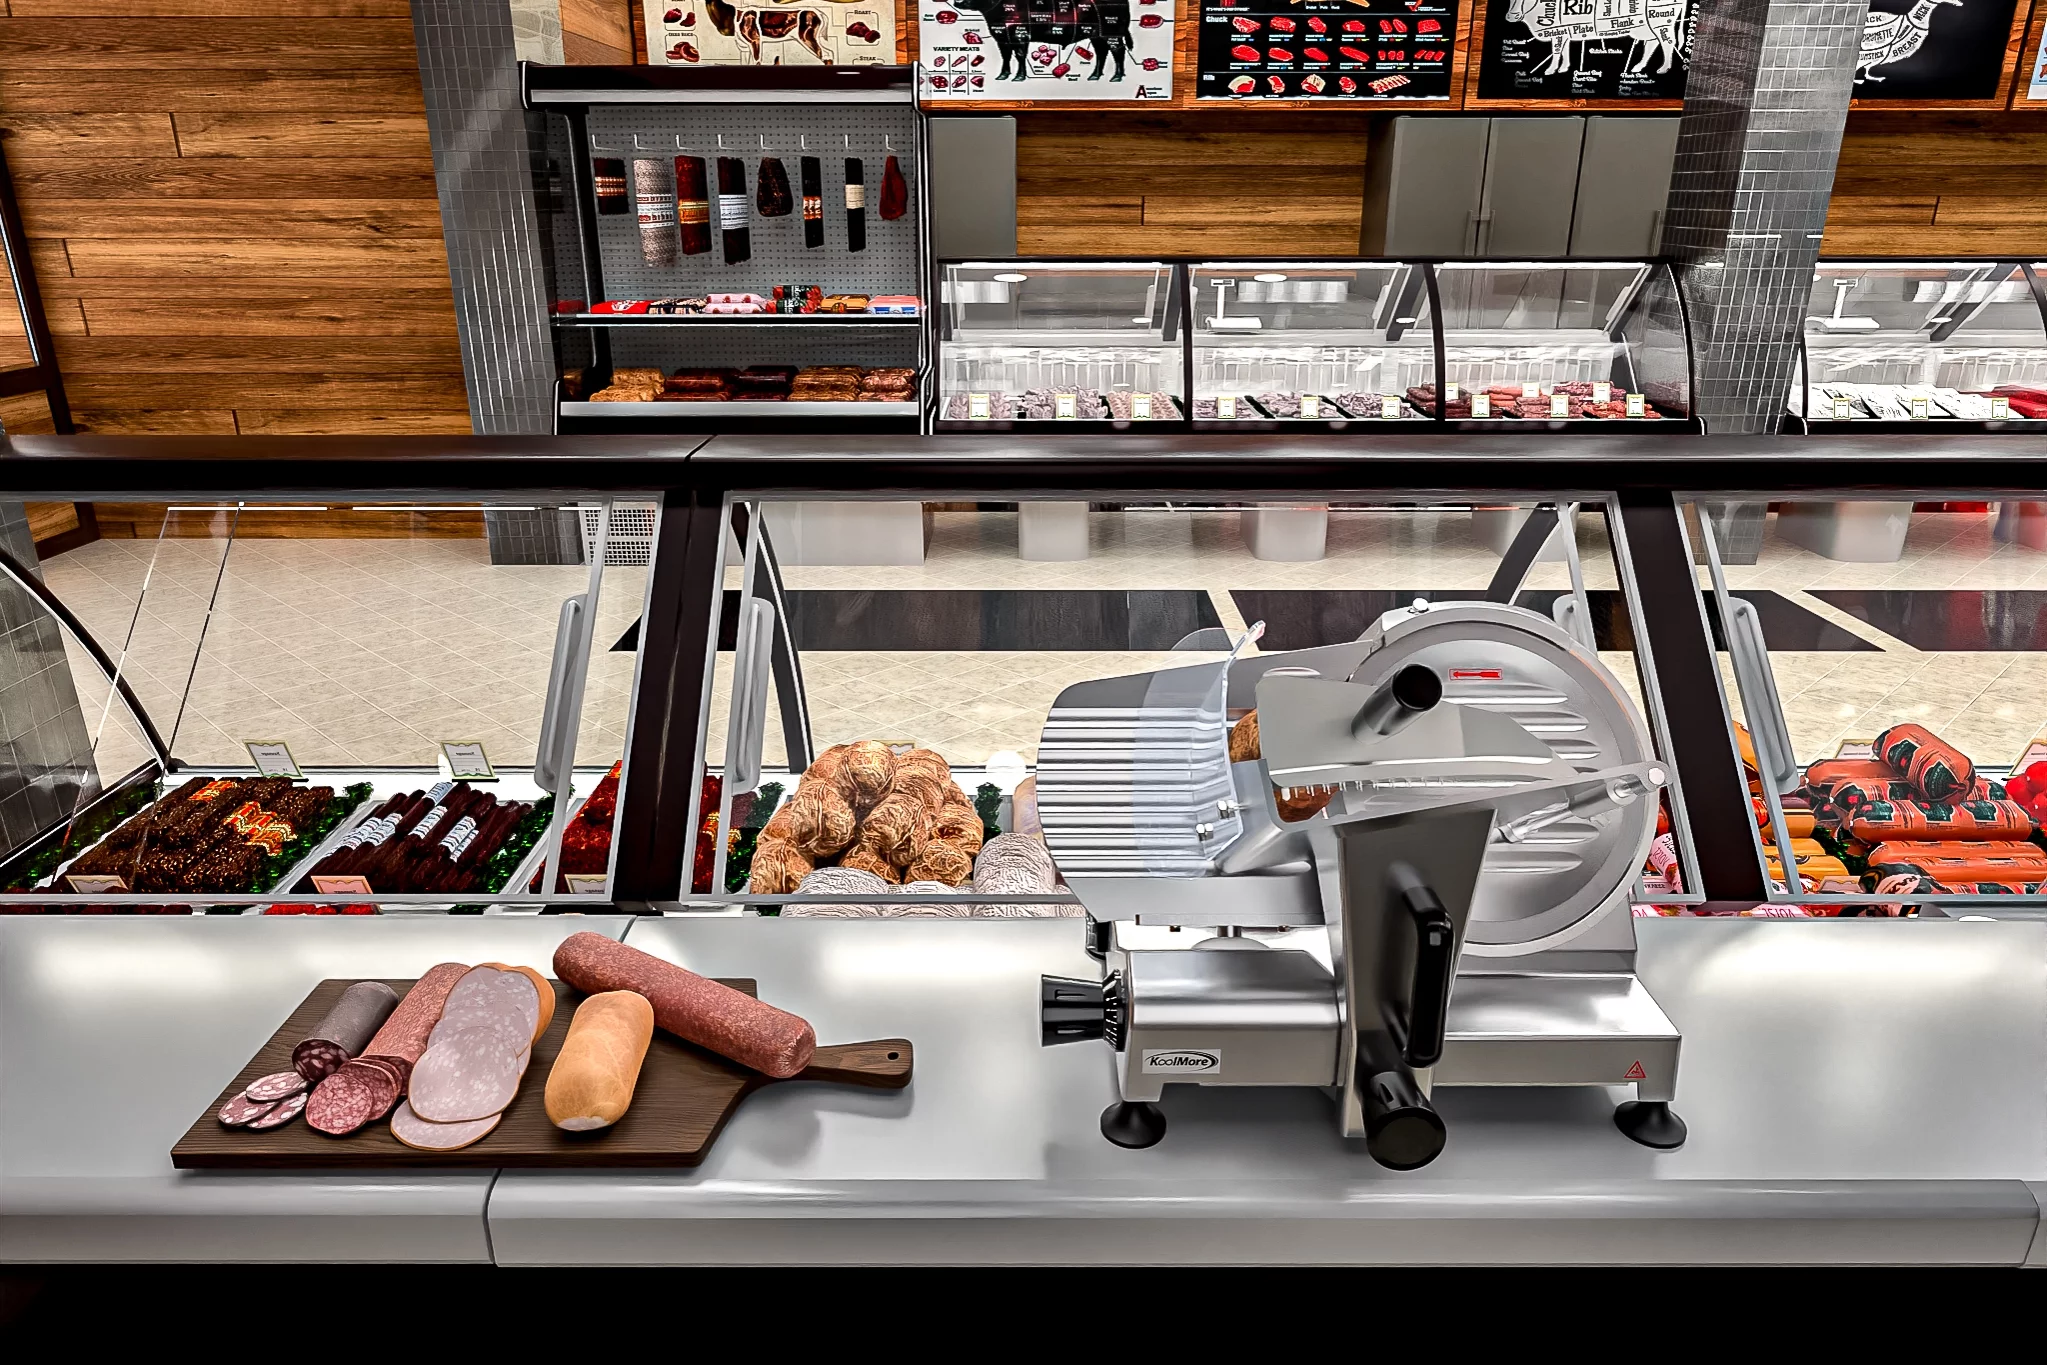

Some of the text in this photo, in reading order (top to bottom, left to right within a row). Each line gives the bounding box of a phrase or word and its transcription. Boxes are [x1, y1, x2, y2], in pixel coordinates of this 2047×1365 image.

[1562, 0, 1593, 15] Rib
[1913, 4, 1930, 21] NECK
[1648, 8, 1675, 18] Round
[1610, 18, 1635, 28] Flank
[1573, 25, 1594, 34] Plate
[1892, 32, 1921, 57] BREAST
[1149, 1056, 1208, 1066] KoolMore
